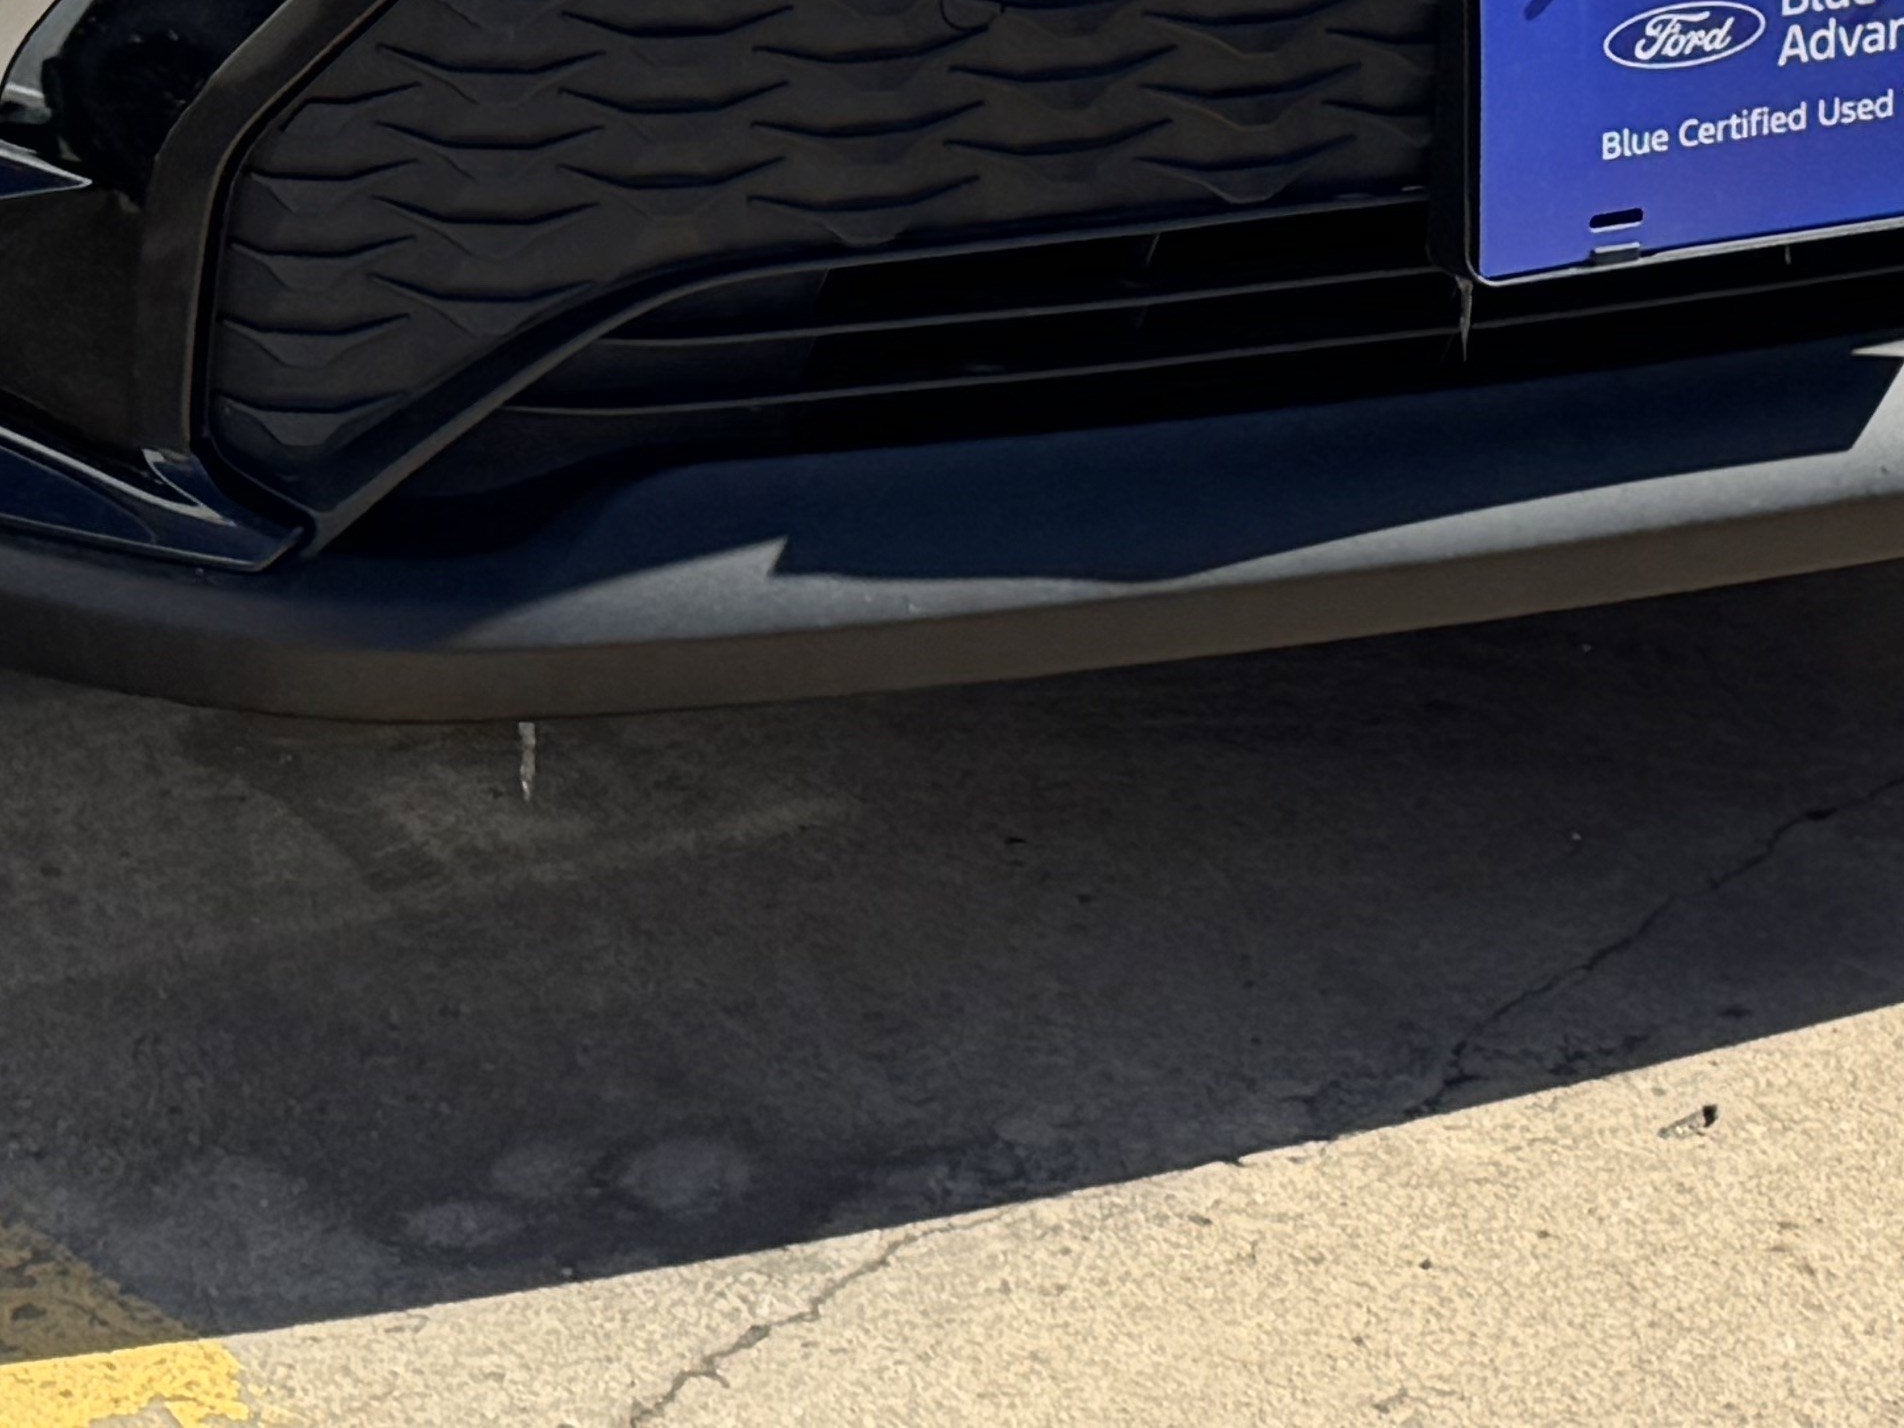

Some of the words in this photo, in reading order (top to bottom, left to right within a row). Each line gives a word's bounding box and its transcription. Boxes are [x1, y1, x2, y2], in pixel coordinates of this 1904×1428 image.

[1634, 10, 1735, 61] Ford
[1602, 127, 1671, 161] Blue
[1677, 101, 1809, 149] Certified
[1818, 88, 1894, 128] Used
